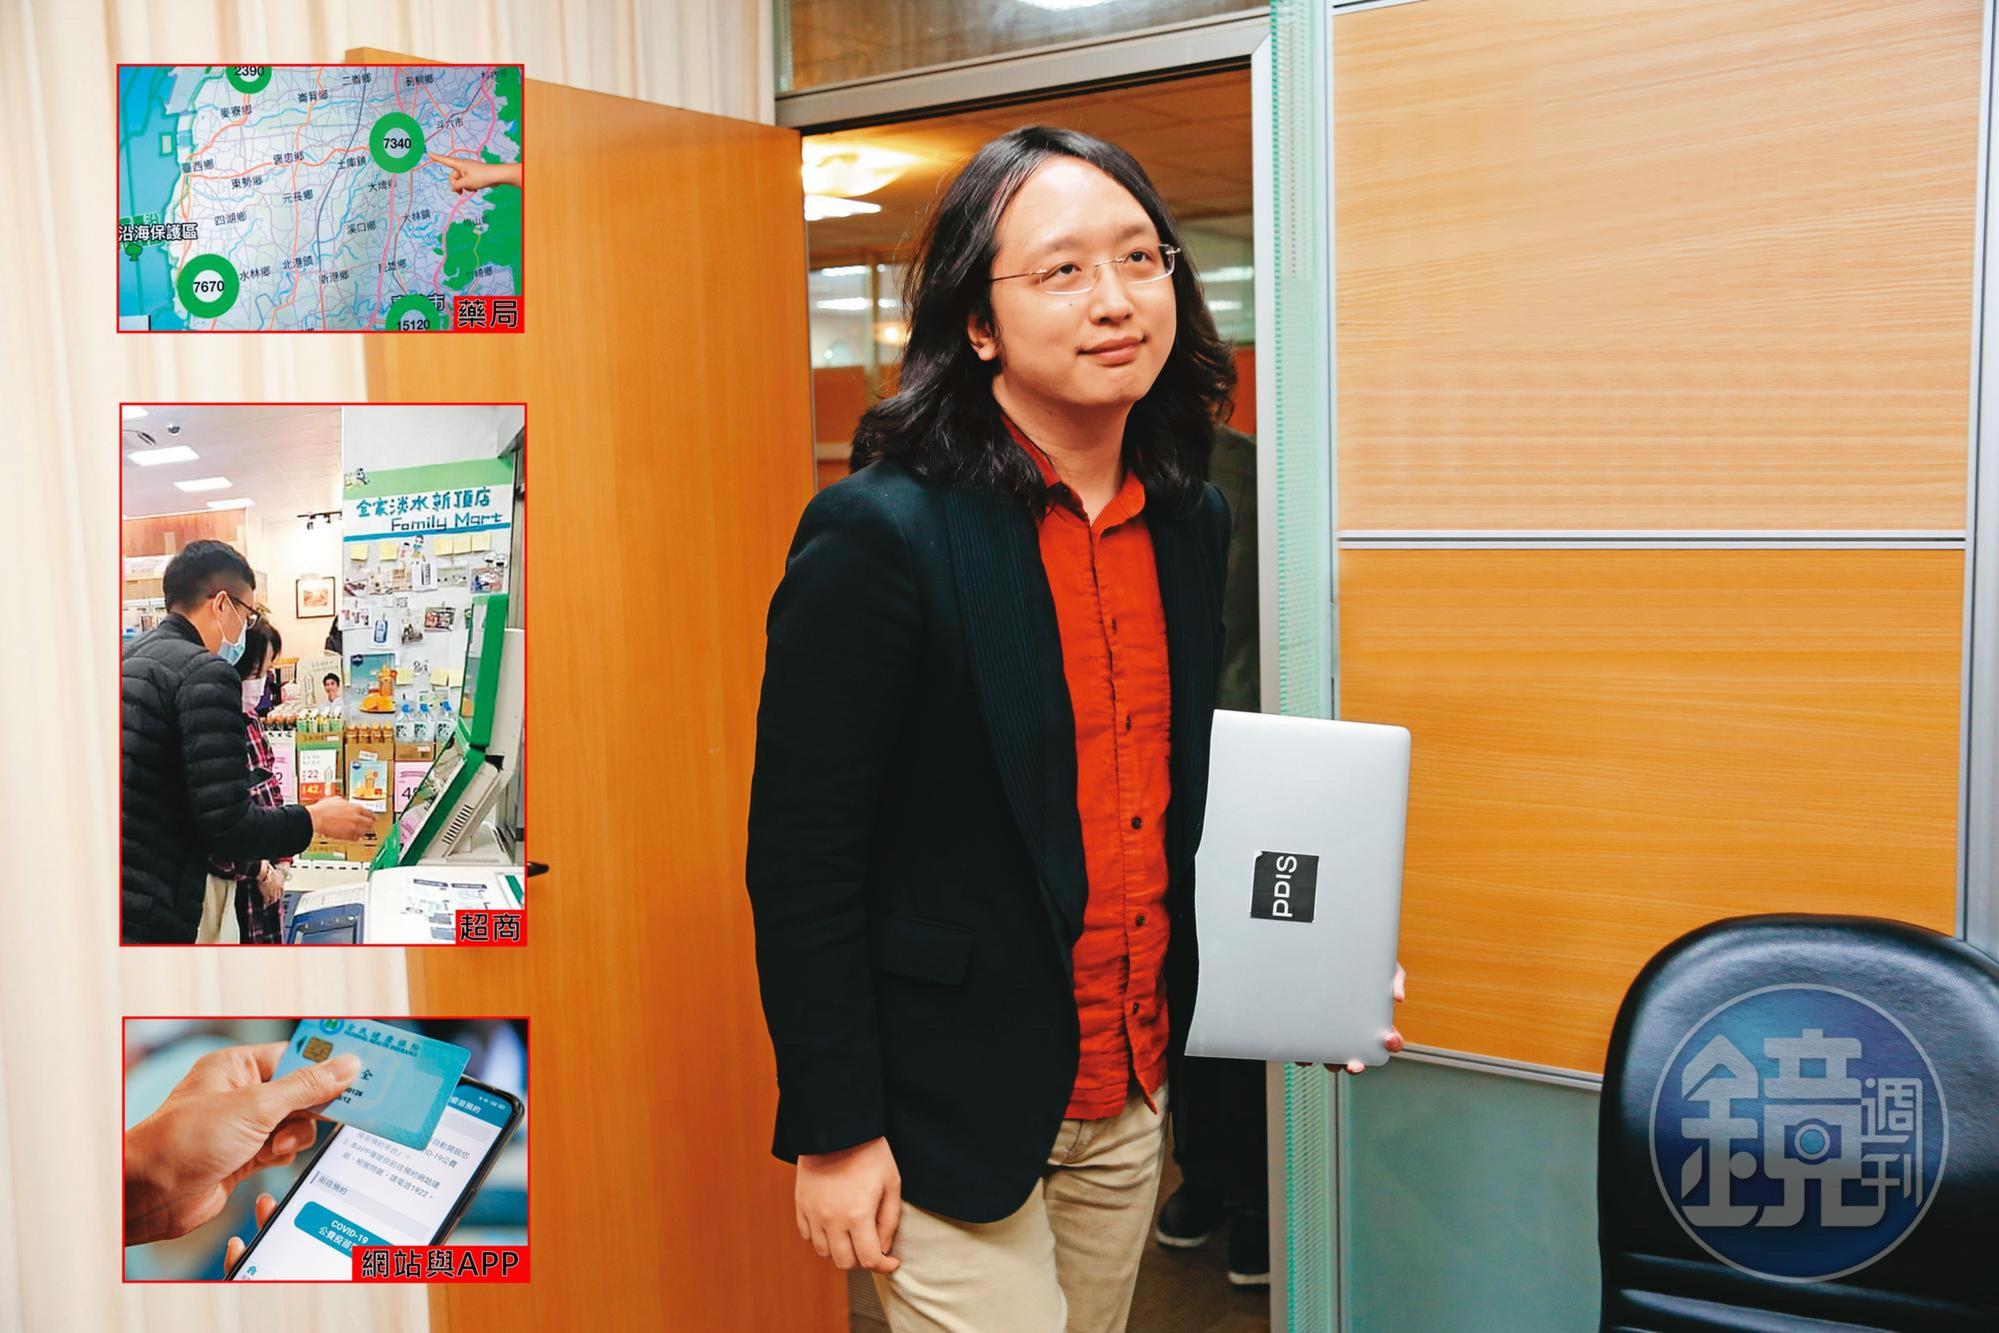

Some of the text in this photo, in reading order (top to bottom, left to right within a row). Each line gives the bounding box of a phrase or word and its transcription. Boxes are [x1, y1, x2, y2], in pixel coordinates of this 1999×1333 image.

[234, 65, 265, 76] 2390
[383, 137, 412, 150] 7340
[214, 210, 247, 226] 四湖鄉
[118, 222, 199, 242] 沿海保護區
[193, 280, 225, 294] 7670
[396, 318, 430, 330] 15120
[391, 512, 503, 531] Family Mart
[1272, 856, 1298, 918] PDIS
[318, 1226, 353, 1252] 公費疫苗
[331, 1219, 369, 1245] COVID-19
